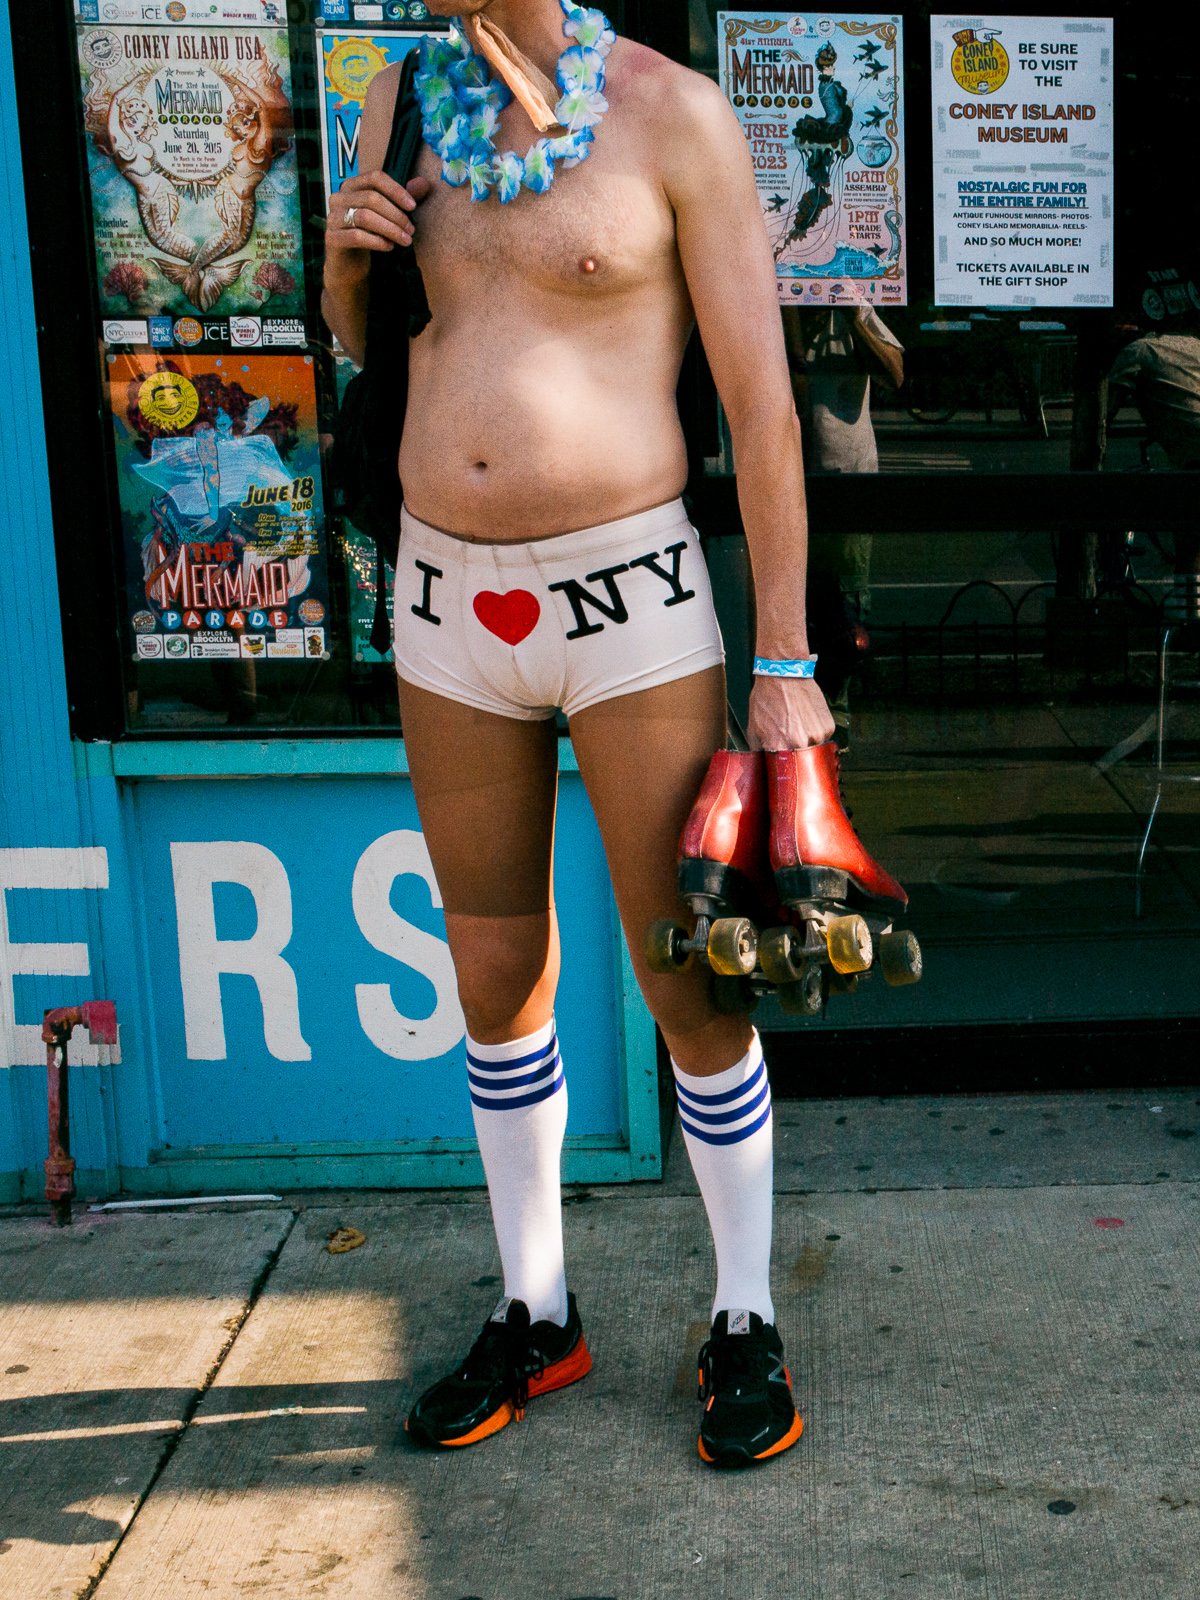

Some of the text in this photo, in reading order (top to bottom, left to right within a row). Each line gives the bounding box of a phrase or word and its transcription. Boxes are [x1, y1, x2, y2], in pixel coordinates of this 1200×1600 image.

[141, 8, 161, 20] ICE
[324, 5, 345, 14] ISLAND
[124, 34, 170, 60] CONEY
[177, 35, 229, 60] ISLAND
[235, 36, 262, 60] USA
[757, 38, 794, 46] ANNUAL
[752, 49, 781, 62] THE
[962, 43, 994, 58] CONEY
[1018, 44, 1078, 55] BE SURE
[963, 57, 998, 73] ISLAND
[1018, 60, 1078, 71] TO VISIT
[732, 49, 814, 94] MERMAID
[1034, 76, 1062, 87] THE
[155, 79, 222, 115] MERMAID
[734, 96, 812, 108] PARADE
[949, 103, 1096, 120] CONEY ISLAND
[159, 115, 222, 124] PARADE
[174, 127, 210, 142] Saturday
[978, 127, 1068, 144] MUSEUM
[163, 141, 183, 154] June
[204, 142, 222, 154] 2015
[845, 171, 885, 184] 10AM
[844, 184, 888, 192] ASSEMBLY
[958, 181, 1087, 194] NOSTALGIC FUN FOR
[958, 196, 1086, 208] THE ENTIRE FAMILY!
[848, 211, 880, 223] 1PM
[953, 212, 984, 220] ANTIQUE
[985, 212, 1024, 220] FUNHOUSE
[1024, 212, 1060, 220] MIRRORS-
[96, 218, 128, 228] Schedule:
[849, 224, 882, 232] PARADE
[957, 222, 980, 230] CONEY
[982, 222, 1008, 230] ISLAND
[1010, 222, 1062, 230] MEMORABILIA-
[850, 232, 882, 240] STARTS
[964, 237, 1082, 247] AND SO MUCH MORE!
[956, 264, 1090, 273] TICKETS AVAILABLE IN
[978, 277, 1068, 286] THE GIFT SHOP
[204, 326, 230, 340] ICE
[240, 476, 314, 508] JUNE 18
[291, 500, 312, 512] 2016
[190, 542, 234, 562] THE
[158, 544, 288, 610] MERMAID
[411, 541, 696, 640] I NY
[164, 610, 286, 628] PARADE
